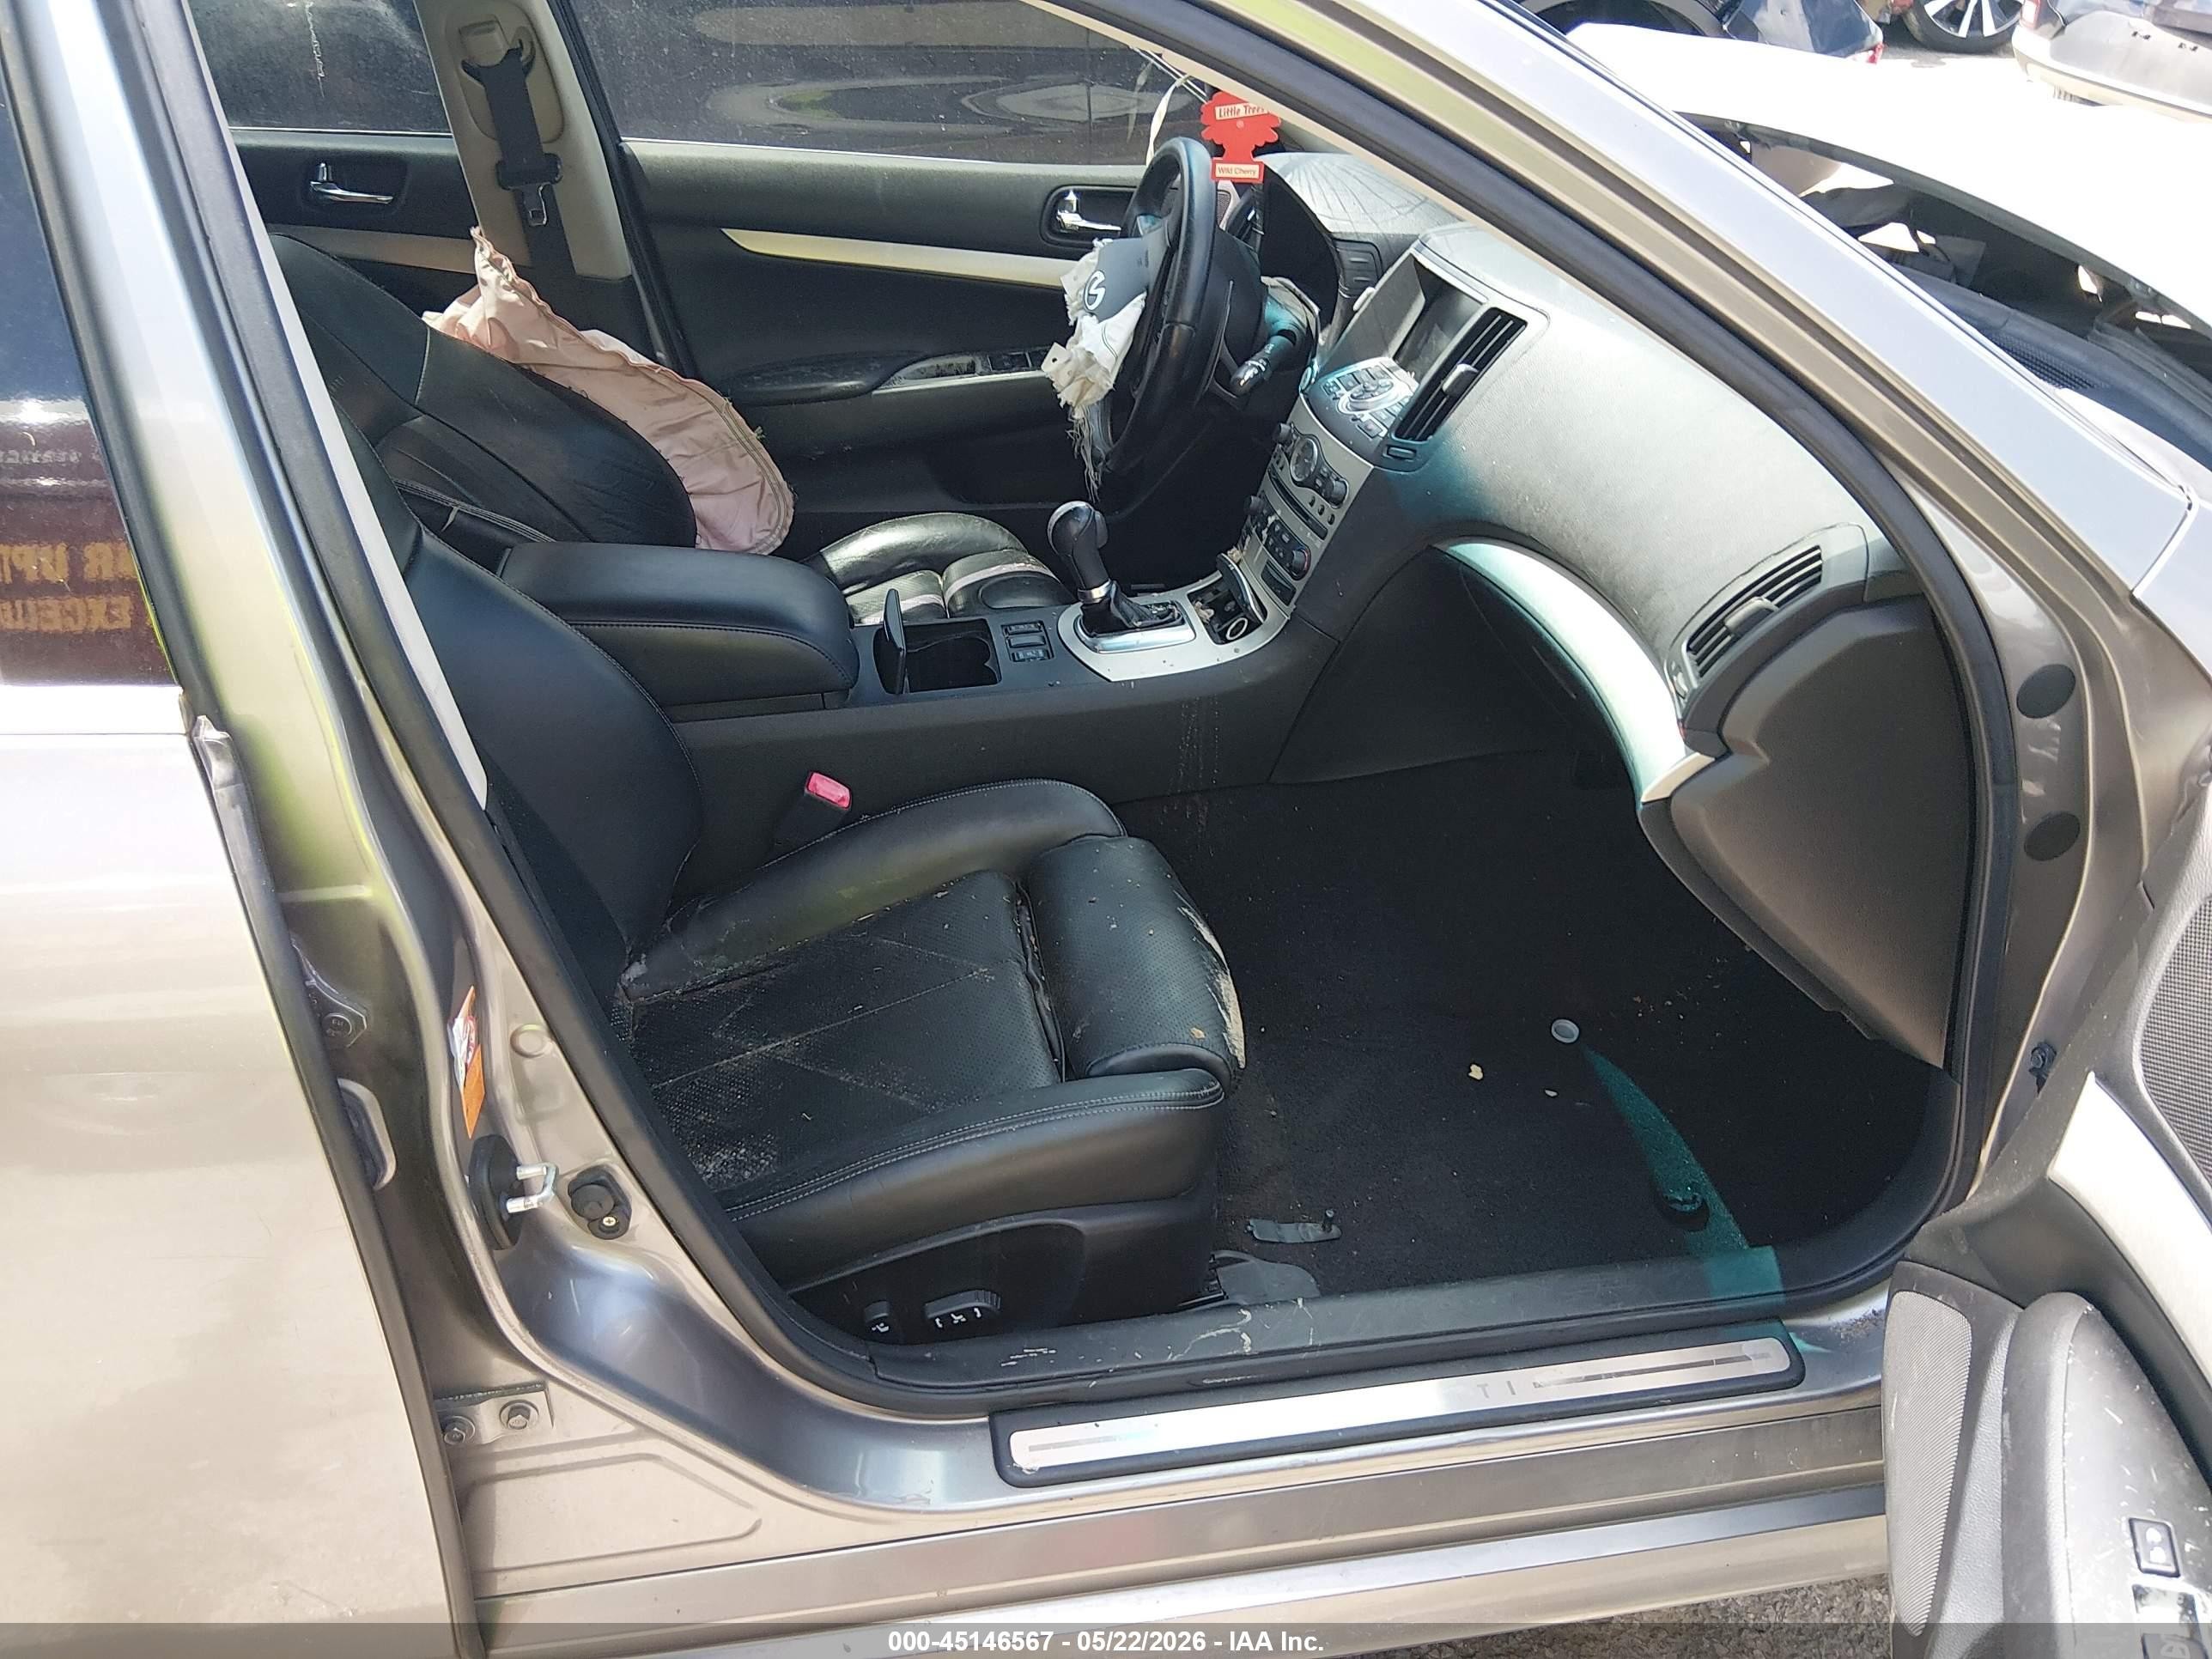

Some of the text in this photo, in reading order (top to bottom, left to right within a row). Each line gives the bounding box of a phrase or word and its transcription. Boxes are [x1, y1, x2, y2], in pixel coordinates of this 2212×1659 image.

[1218, 106, 1241, 118] Little
[1218, 166, 1257, 177] Wild Cherry
